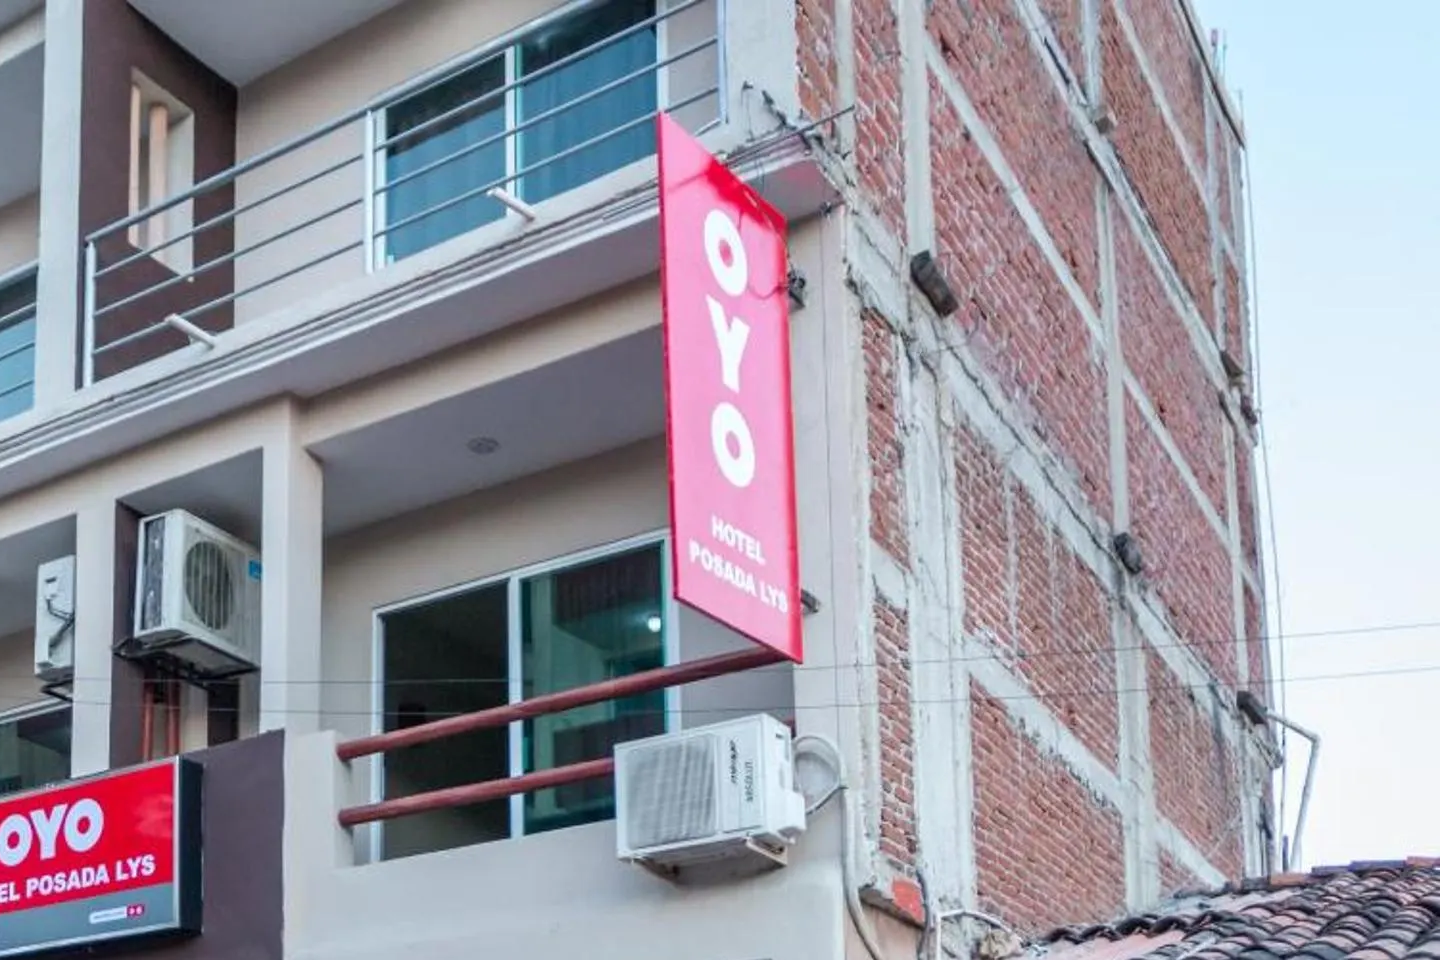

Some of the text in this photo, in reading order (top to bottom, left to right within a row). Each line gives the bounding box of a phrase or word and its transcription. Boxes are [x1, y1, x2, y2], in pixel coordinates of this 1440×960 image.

[703, 209, 756, 488] OYO
[711, 513, 767, 566] HOTEL
[688, 538, 788, 613] POSADA LYS
[25, 863, 109, 899] POSADA
[115, 853, 156, 882] LYS
